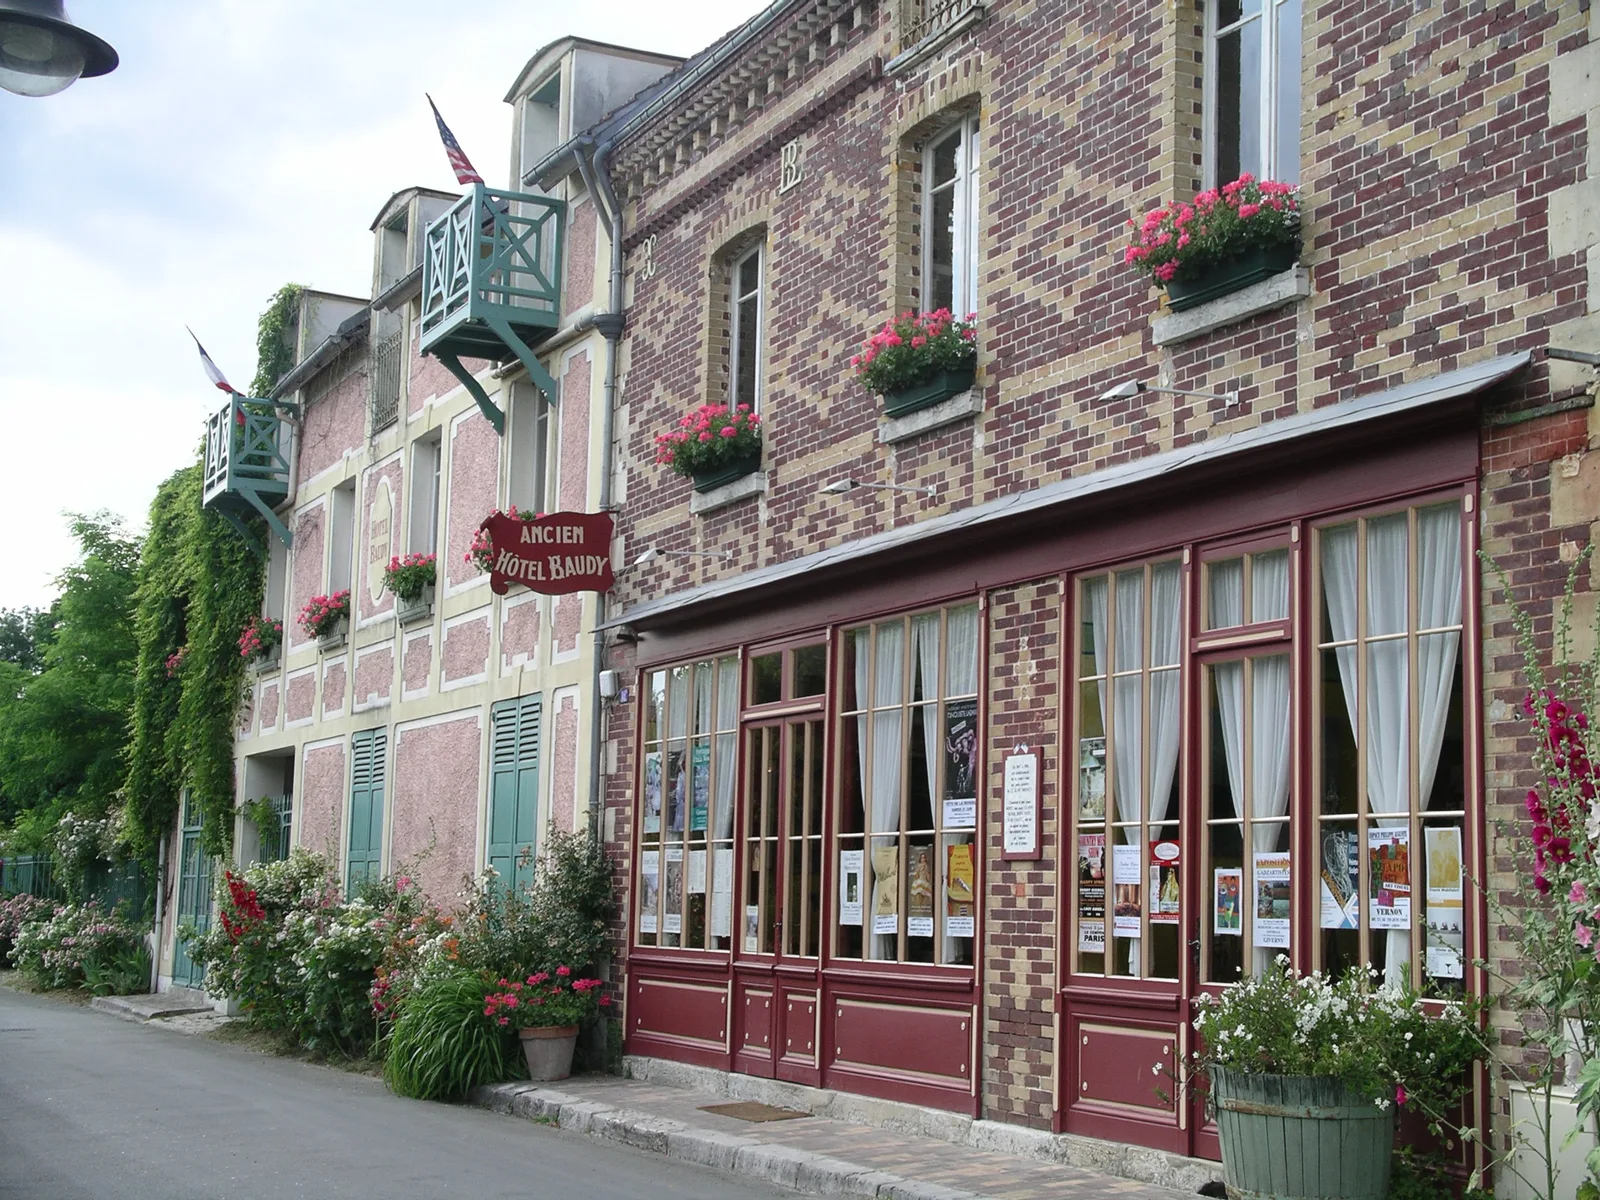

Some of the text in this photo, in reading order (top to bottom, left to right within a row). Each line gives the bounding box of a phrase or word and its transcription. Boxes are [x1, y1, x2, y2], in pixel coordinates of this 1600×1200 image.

[520, 526, 584, 544] ANCIEN
[494, 547, 608, 581] HÔTEL BAUDY
[1376, 908, 1403, 916] VERNON
